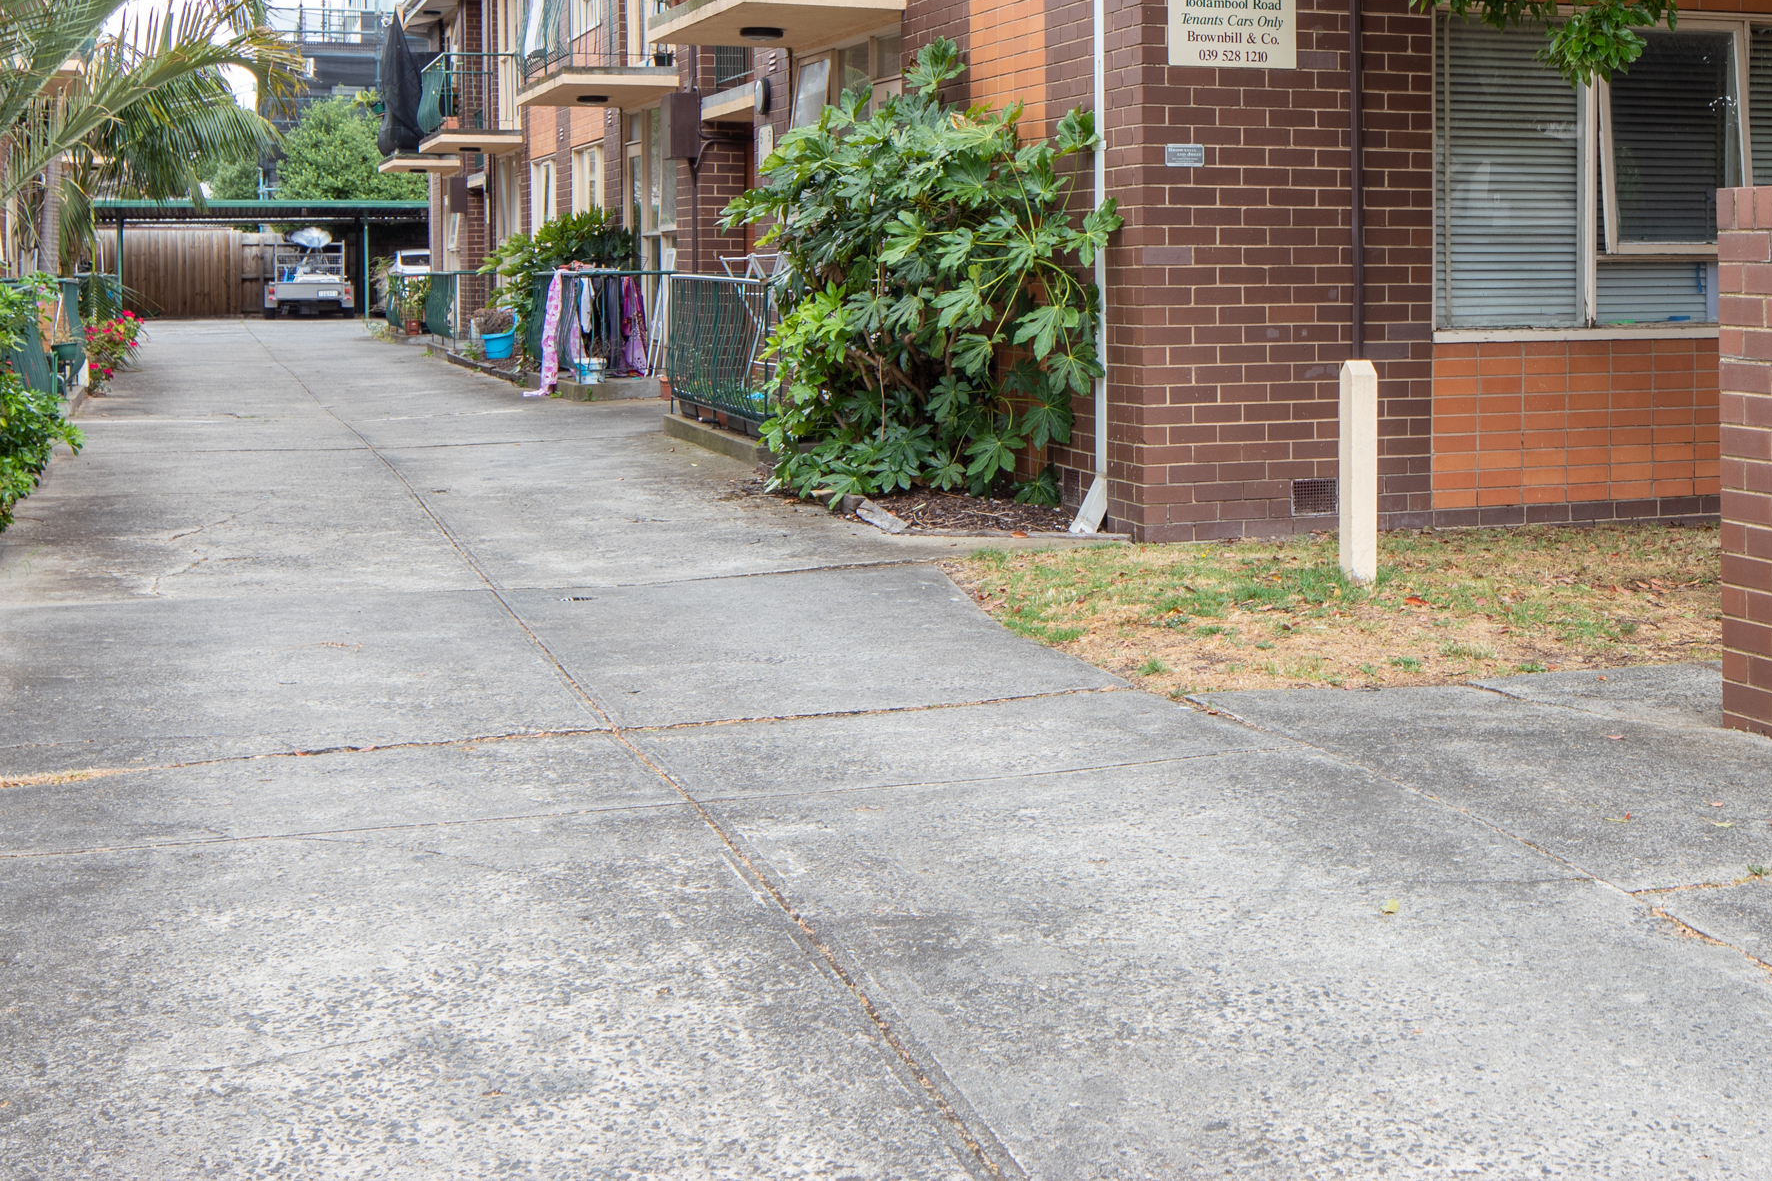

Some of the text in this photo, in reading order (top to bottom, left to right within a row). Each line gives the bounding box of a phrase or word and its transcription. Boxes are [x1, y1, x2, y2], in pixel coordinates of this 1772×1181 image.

[1181, 13, 1284, 31] Tenants Cars Only
[1187, 31, 1280, 45] Brownbill & Co.
[1198, 49, 1268, 63] 039 528 1210
